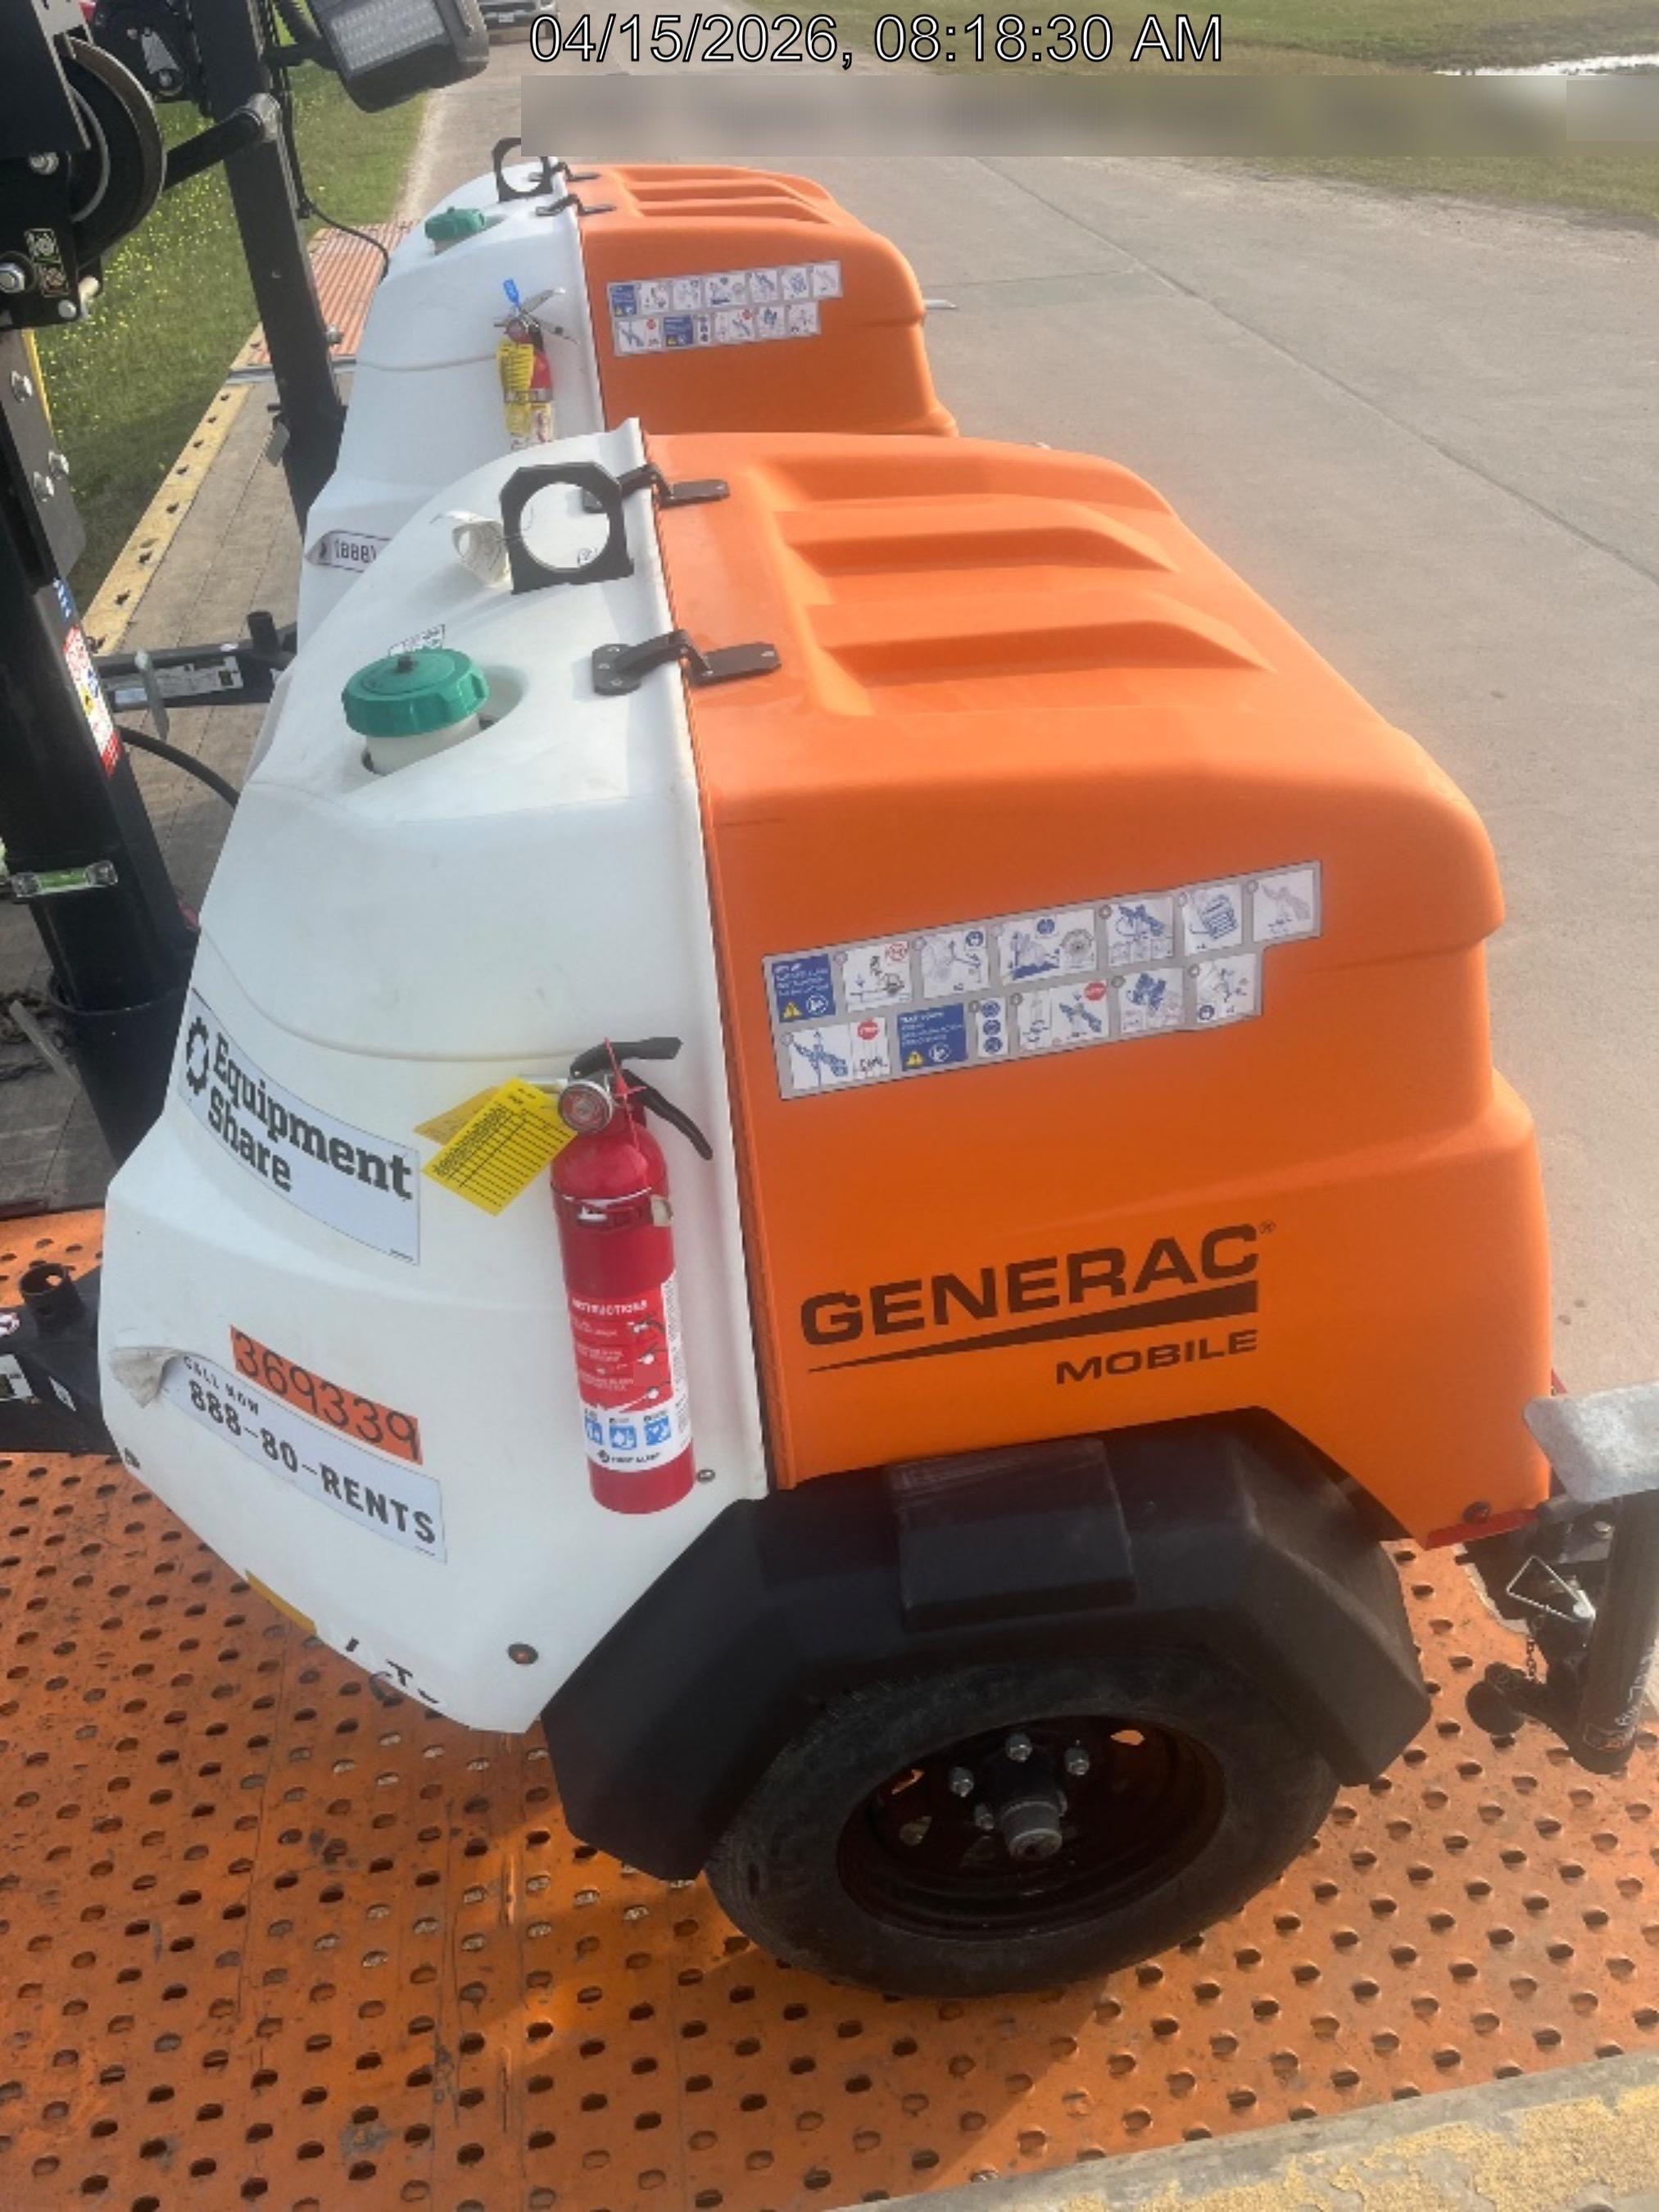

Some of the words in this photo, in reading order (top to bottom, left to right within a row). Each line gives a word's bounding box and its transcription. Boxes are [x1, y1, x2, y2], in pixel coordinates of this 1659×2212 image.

[213, 1031, 413, 1202] Equipment
[800, 1223, 1259, 1346] GENERAC
[183, 1355, 220, 1390] CALL
[225, 1382, 259, 1416] NOW
[233, 1330, 420, 1461] 369339
[1056, 1329, 1258, 1385] MOBILE
[188, 1379, 436, 1544] 888-80-RENTS
